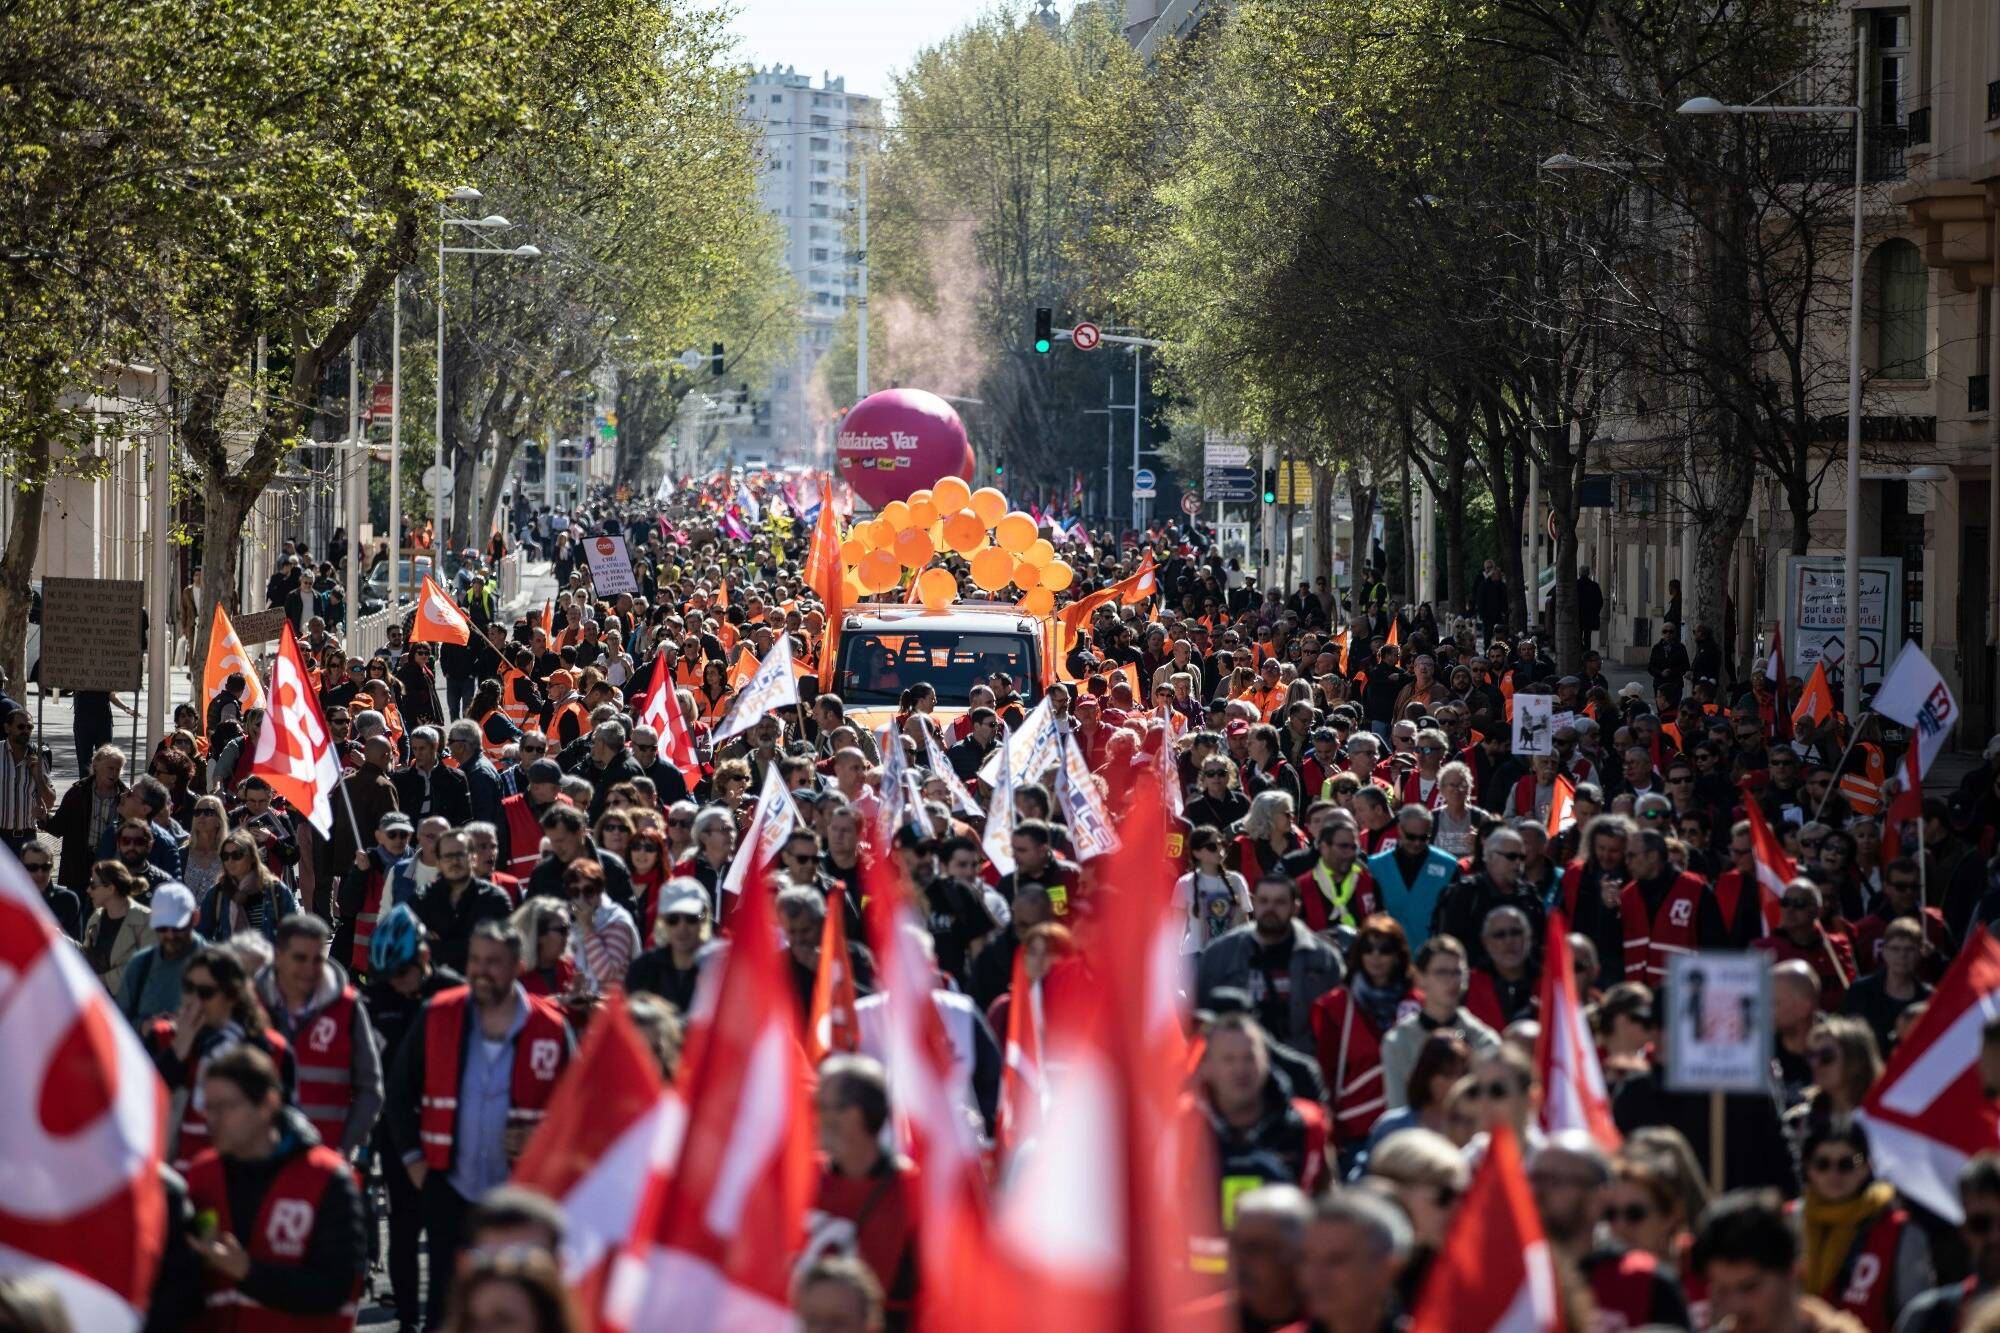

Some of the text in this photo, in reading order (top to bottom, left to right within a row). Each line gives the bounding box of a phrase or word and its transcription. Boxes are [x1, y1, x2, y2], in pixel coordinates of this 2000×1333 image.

[890, 431, 919, 450] Var
[1804, 604, 1869, 614] sur le chin
[1804, 615, 1816, 624] de
[1818, 616, 1827, 624] la
[1669, 898, 1692, 920] FO
[309, 1016, 337, 1044] FO
[531, 1039, 560, 1069] FO
[267, 1199, 314, 1242] FO
